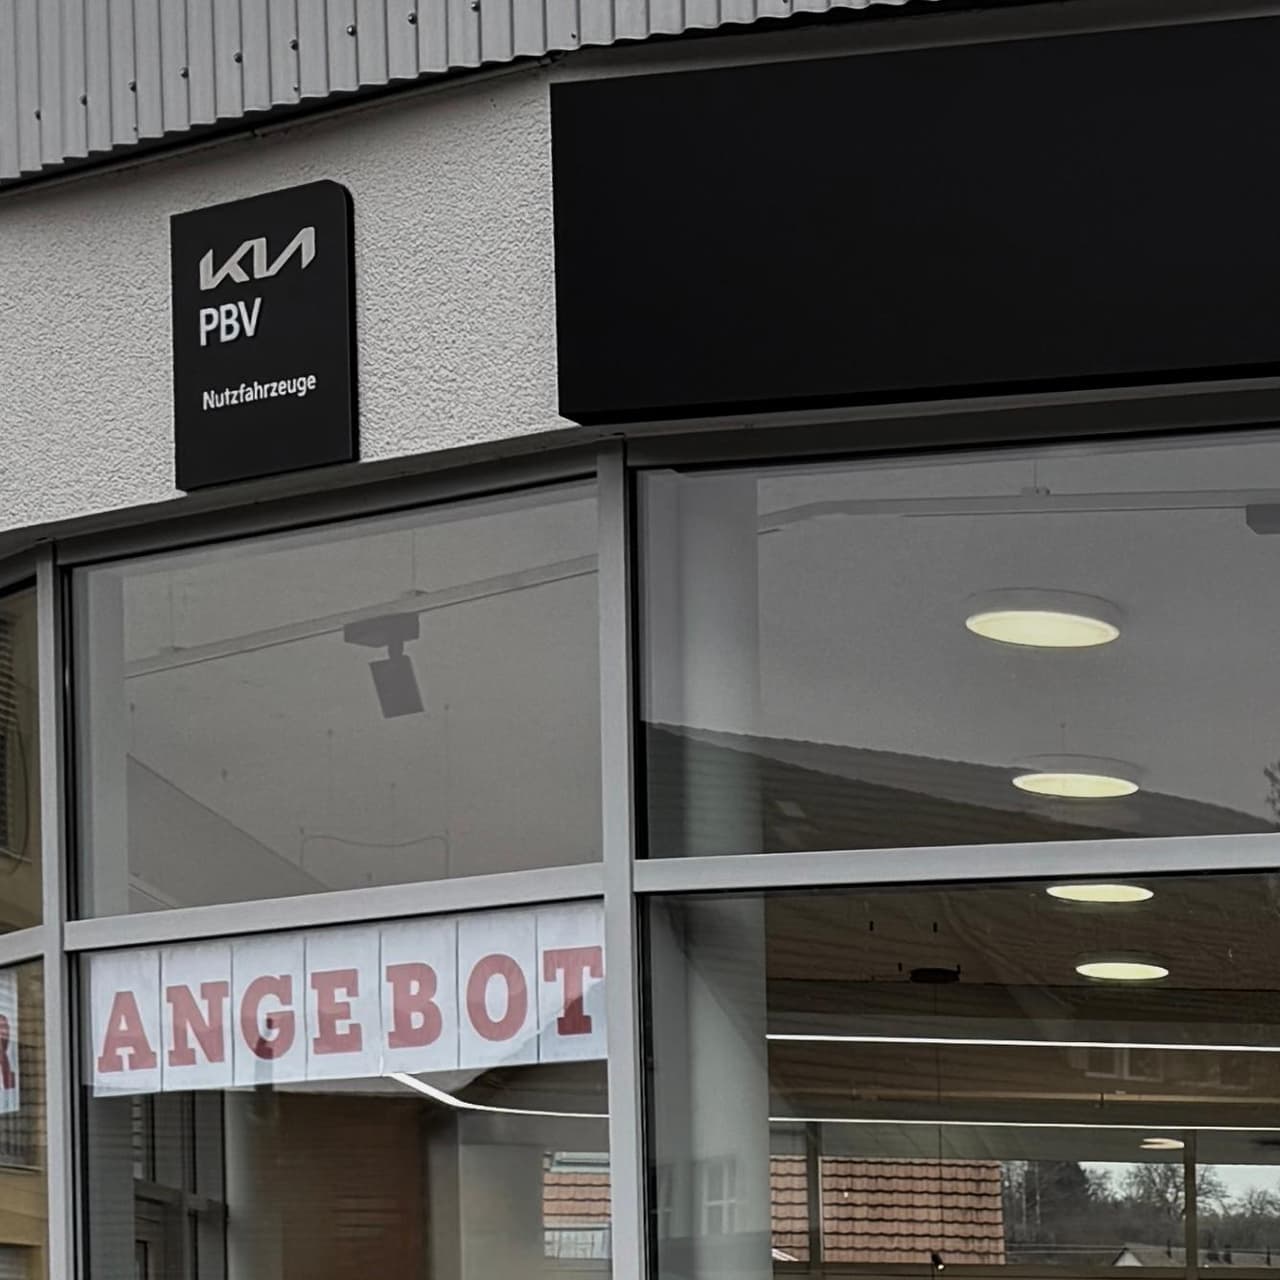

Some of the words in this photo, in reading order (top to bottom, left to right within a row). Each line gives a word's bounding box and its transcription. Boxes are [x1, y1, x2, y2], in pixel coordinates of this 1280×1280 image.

[199, 226, 316, 291] KIA
[199, 297, 262, 346] PBV
[202, 374, 317, 411] Nutzfahrzeuge
[97, 945, 604, 1074] ANGEBOT
